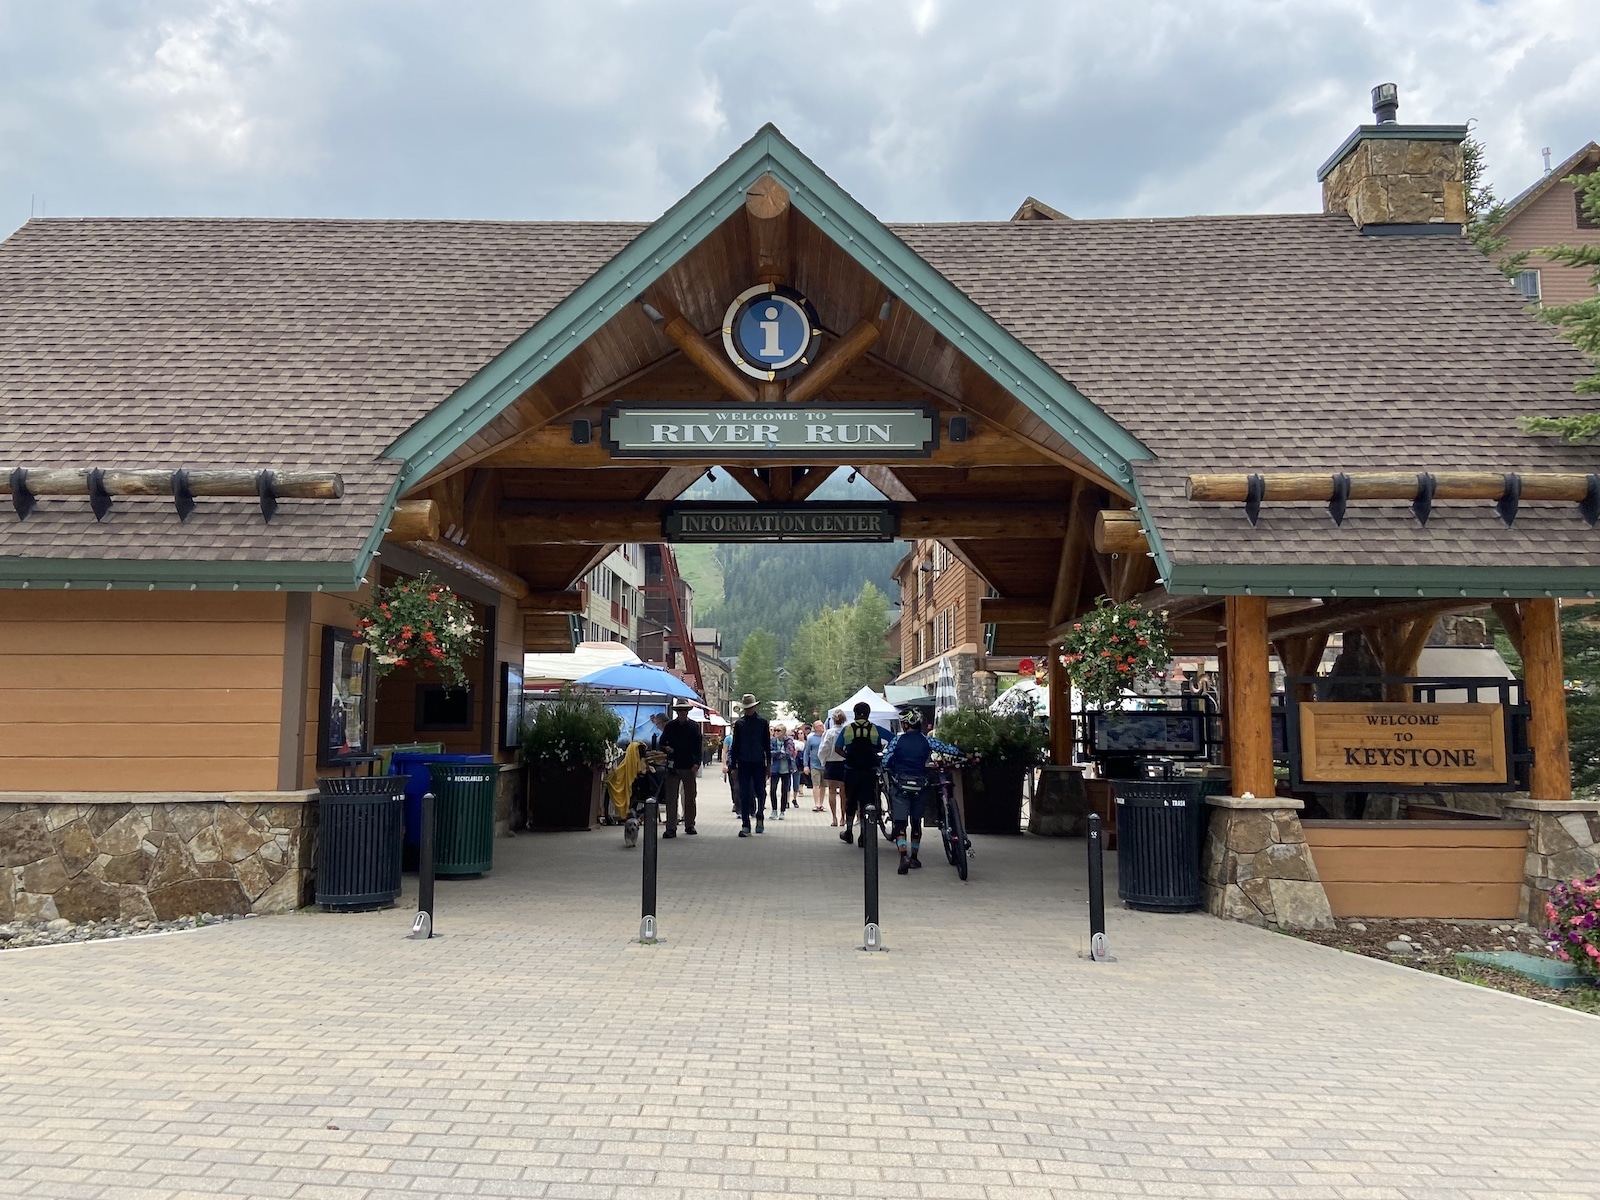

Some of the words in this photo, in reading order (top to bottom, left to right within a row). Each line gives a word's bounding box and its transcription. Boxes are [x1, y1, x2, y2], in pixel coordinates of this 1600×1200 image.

[759, 307, 784, 356] i
[717, 412, 797, 421] WELCOME
[807, 412, 827, 421] TO
[651, 424, 780, 443] RIVER
[805, 424, 892, 443] RUN
[681, 515, 804, 532] INFORMATION
[811, 515, 881, 532] CENTER
[1366, 715, 1439, 725] WELCOME
[1394, 733, 1413, 742] TO
[1344, 747, 1476, 767] KEYSTONE
